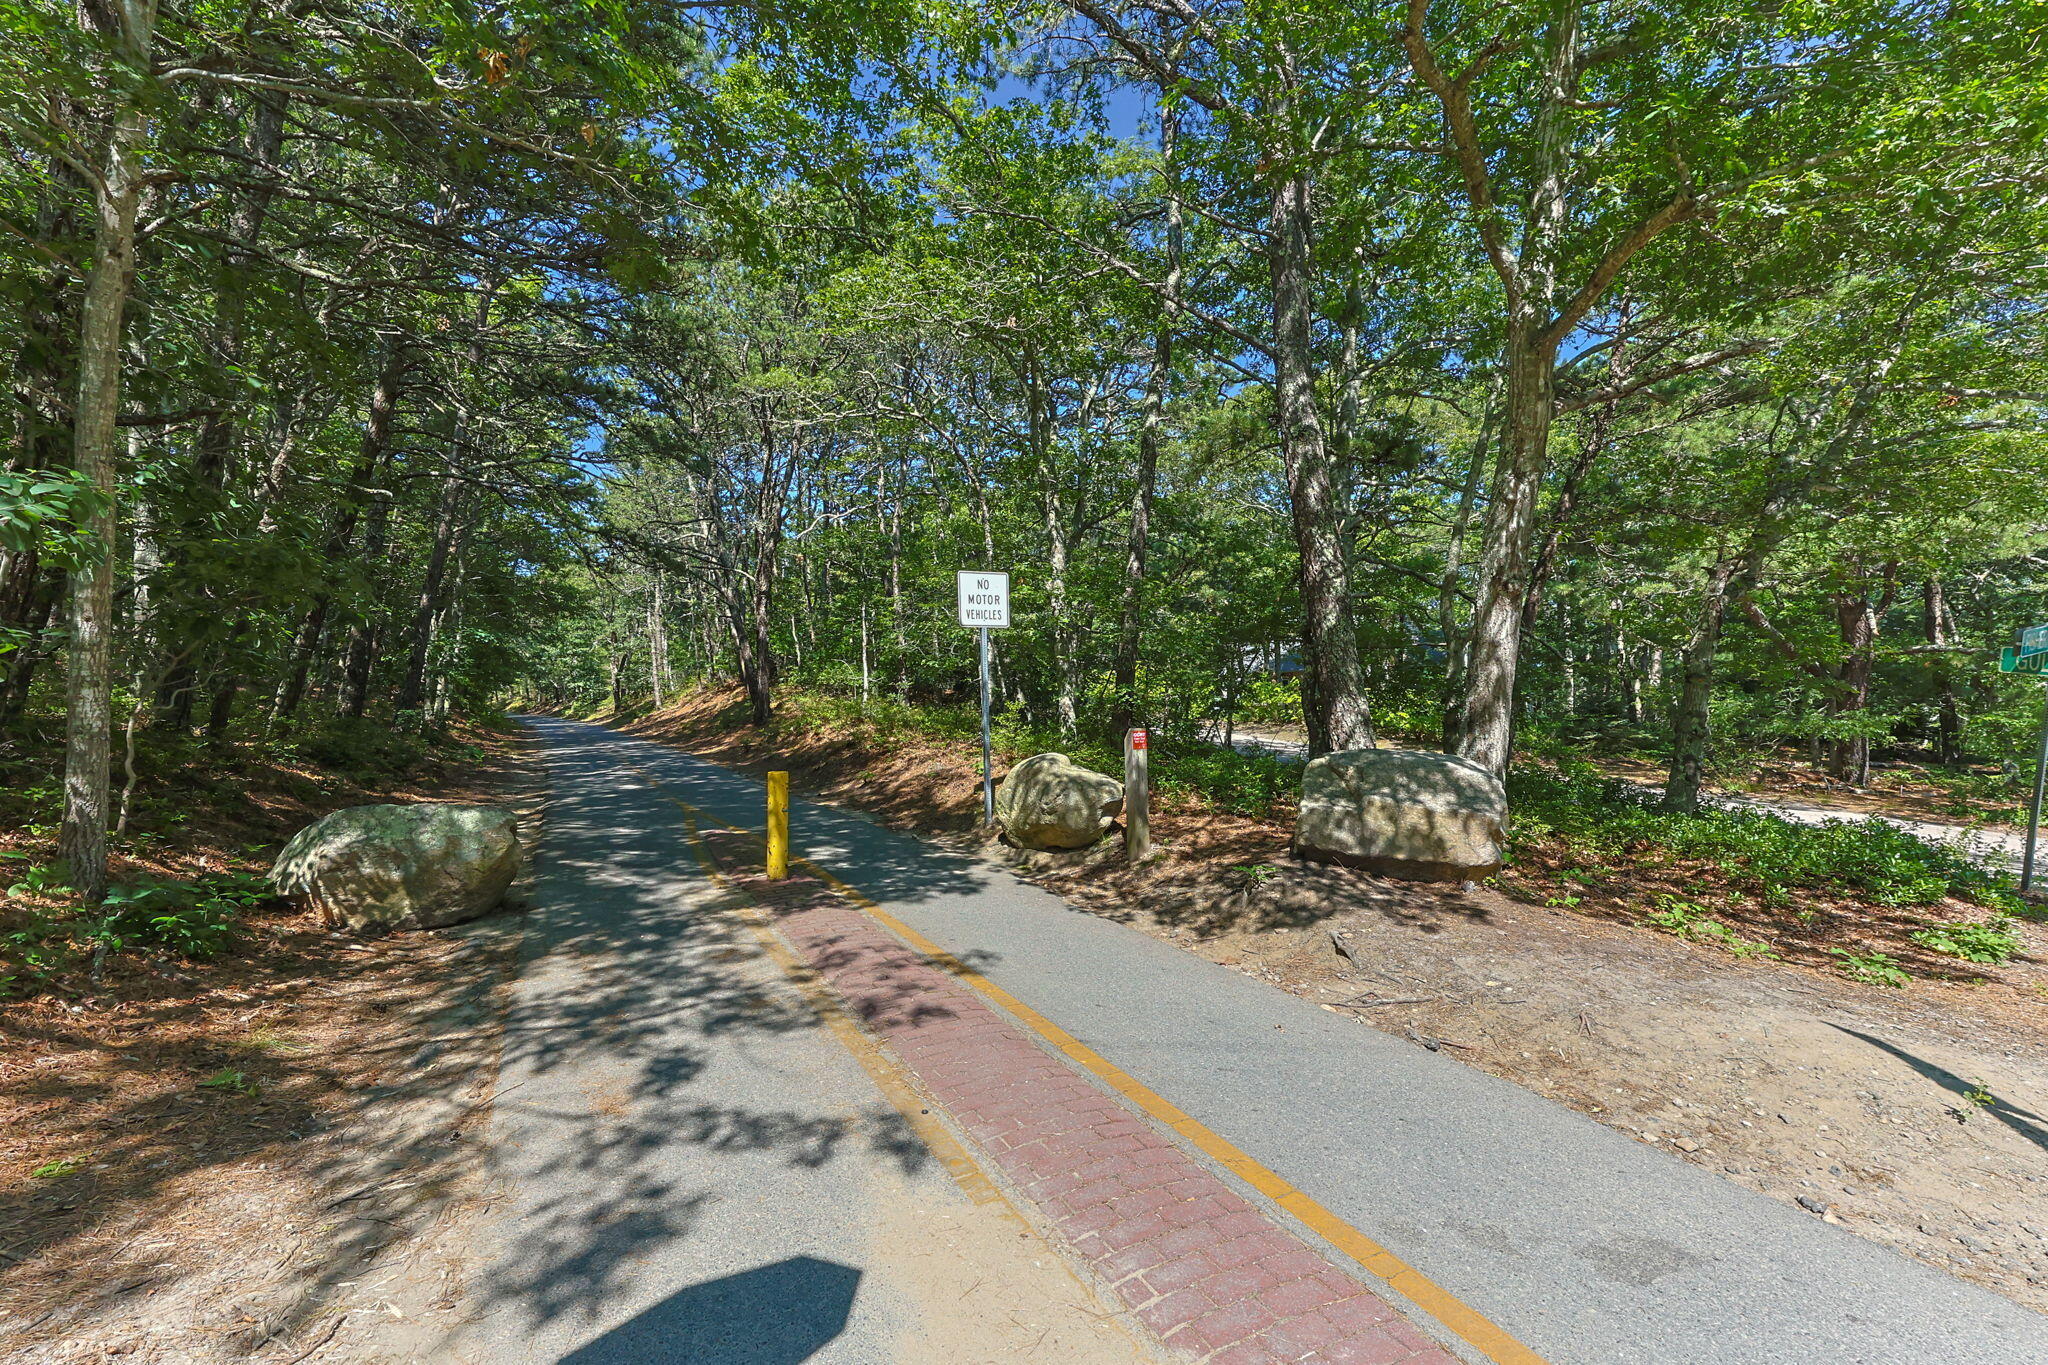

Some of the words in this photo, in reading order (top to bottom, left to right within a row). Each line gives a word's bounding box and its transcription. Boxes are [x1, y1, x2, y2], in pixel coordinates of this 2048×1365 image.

[977, 579, 990, 590] NO
[968, 594, 1001, 605] MOTOR
[966, 609, 1002, 620] VEHICLES
